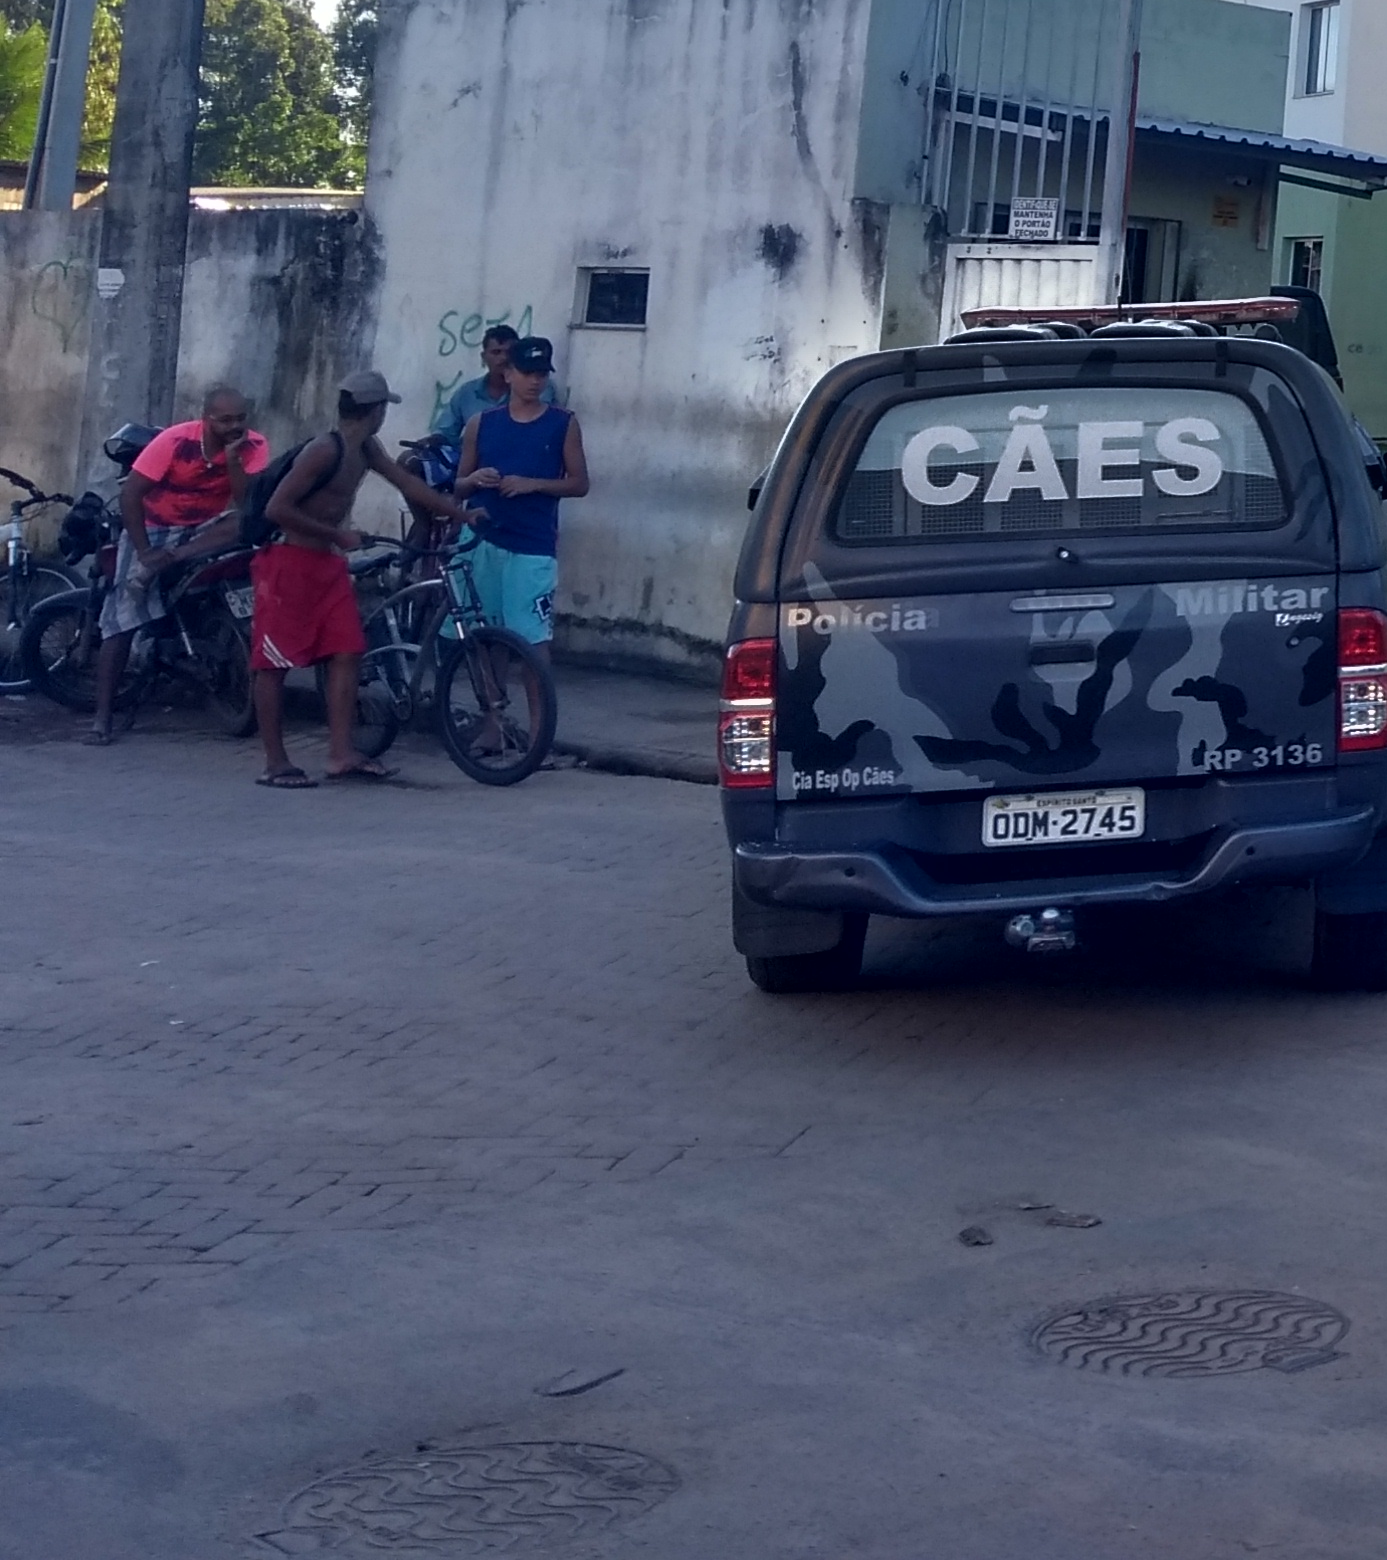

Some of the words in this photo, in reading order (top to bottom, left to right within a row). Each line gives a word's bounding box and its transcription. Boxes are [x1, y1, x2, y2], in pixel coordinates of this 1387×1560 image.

[902, 404, 1222, 505] CÃES
[1176, 583, 1329, 617] Militar
[787, 604, 927, 635] Polícia
[1203, 748, 1242, 771] RP
[1252, 742, 1323, 768] 3136
[792, 771, 813, 790] Cia
[815, 770, 839, 793] Esp
[842, 768, 860, 791] Op
[863, 766, 894, 786] Cães
